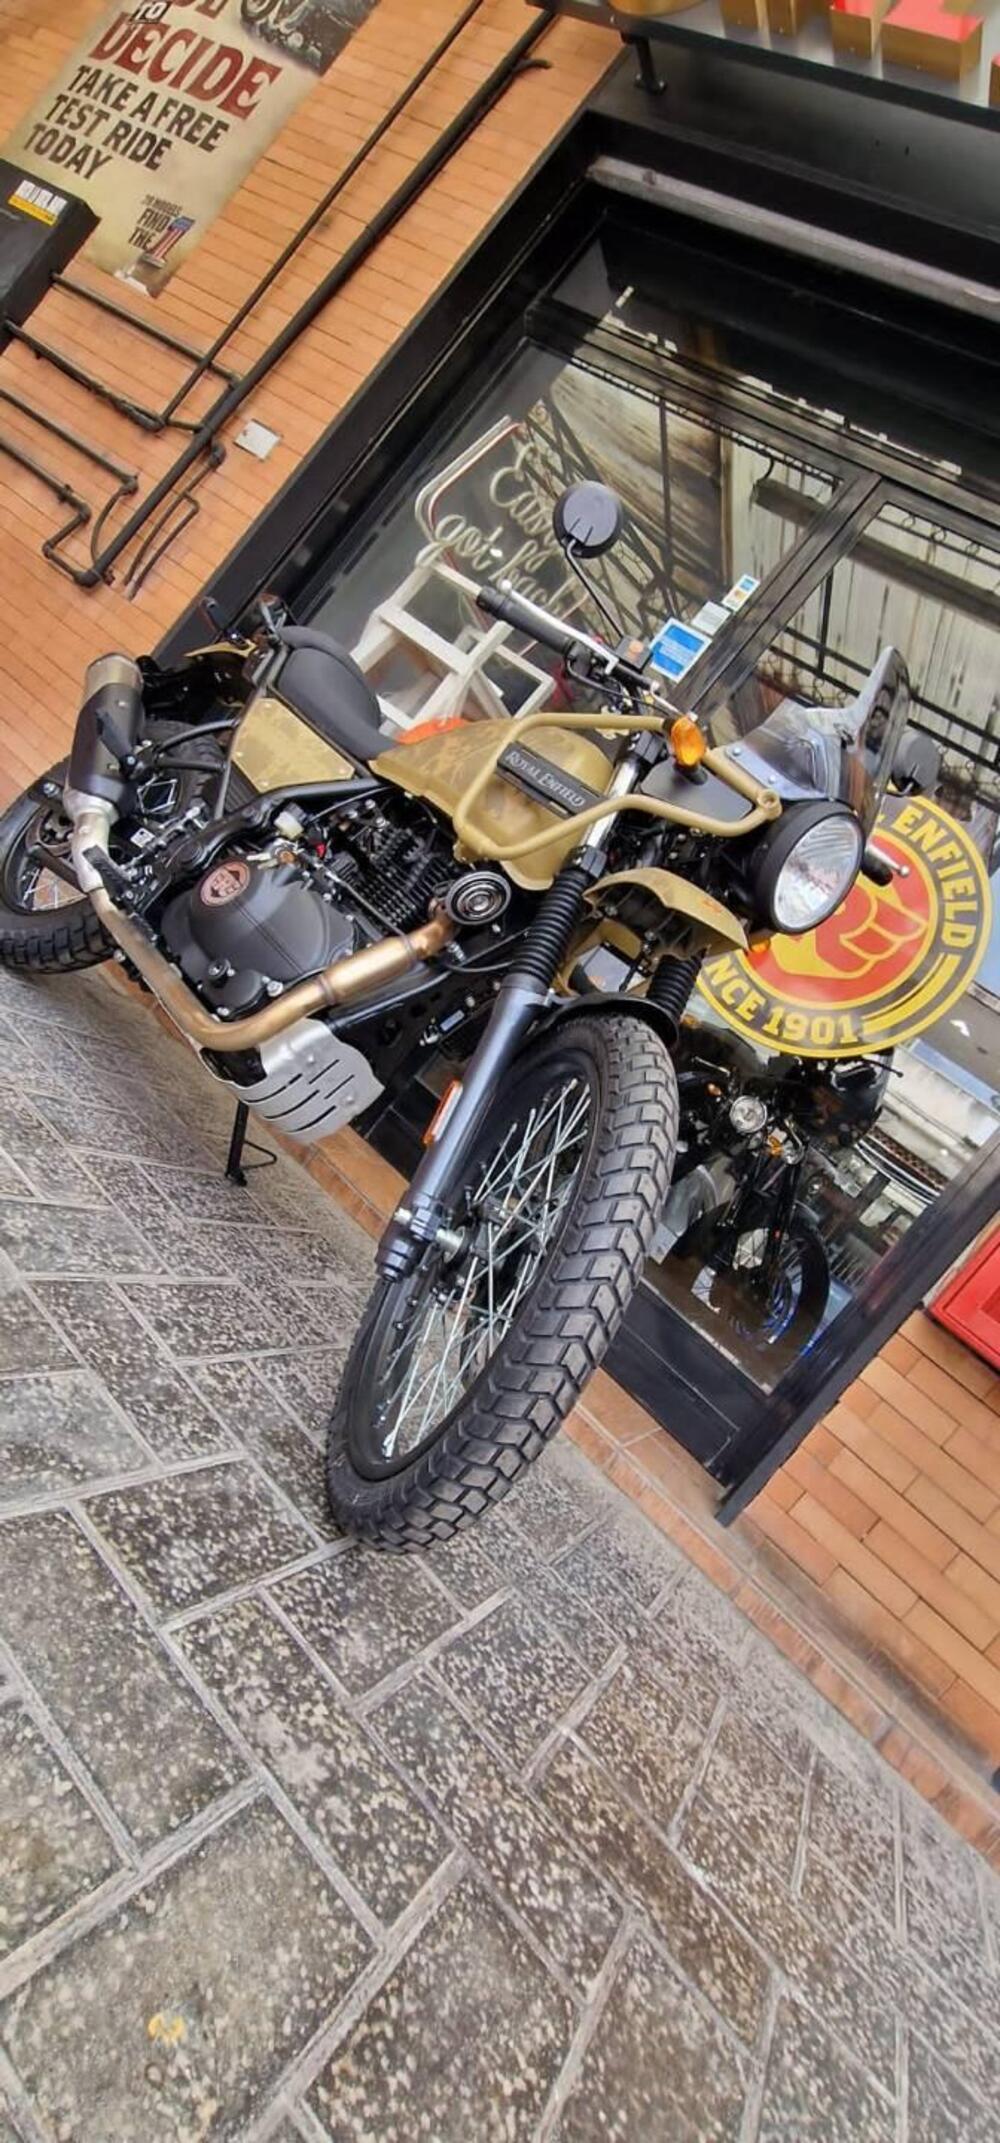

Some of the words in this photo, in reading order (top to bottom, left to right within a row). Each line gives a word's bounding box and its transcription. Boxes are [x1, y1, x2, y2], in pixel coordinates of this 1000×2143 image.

[133, 0, 168, 20] TO
[89, 12, 283, 120] DECIDE
[45, 94, 110, 137] TEST
[102, 120, 173, 171] RIDE
[67, 65, 139, 112] TAKE
[130, 91, 158, 123] A
[152, 97, 230, 153] FREE
[23, 123, 113, 180] TODAY
[128, 226, 156, 250] THE
[137, 208, 171, 232] FIND
[505, 751, 541, 779] ROYAL
[538, 773, 586, 806] ENFIELD
[891, 805, 977, 948] ENFIELD
[704, 955, 766, 1021] NCE
[762, 1005, 859, 1045] 1901
